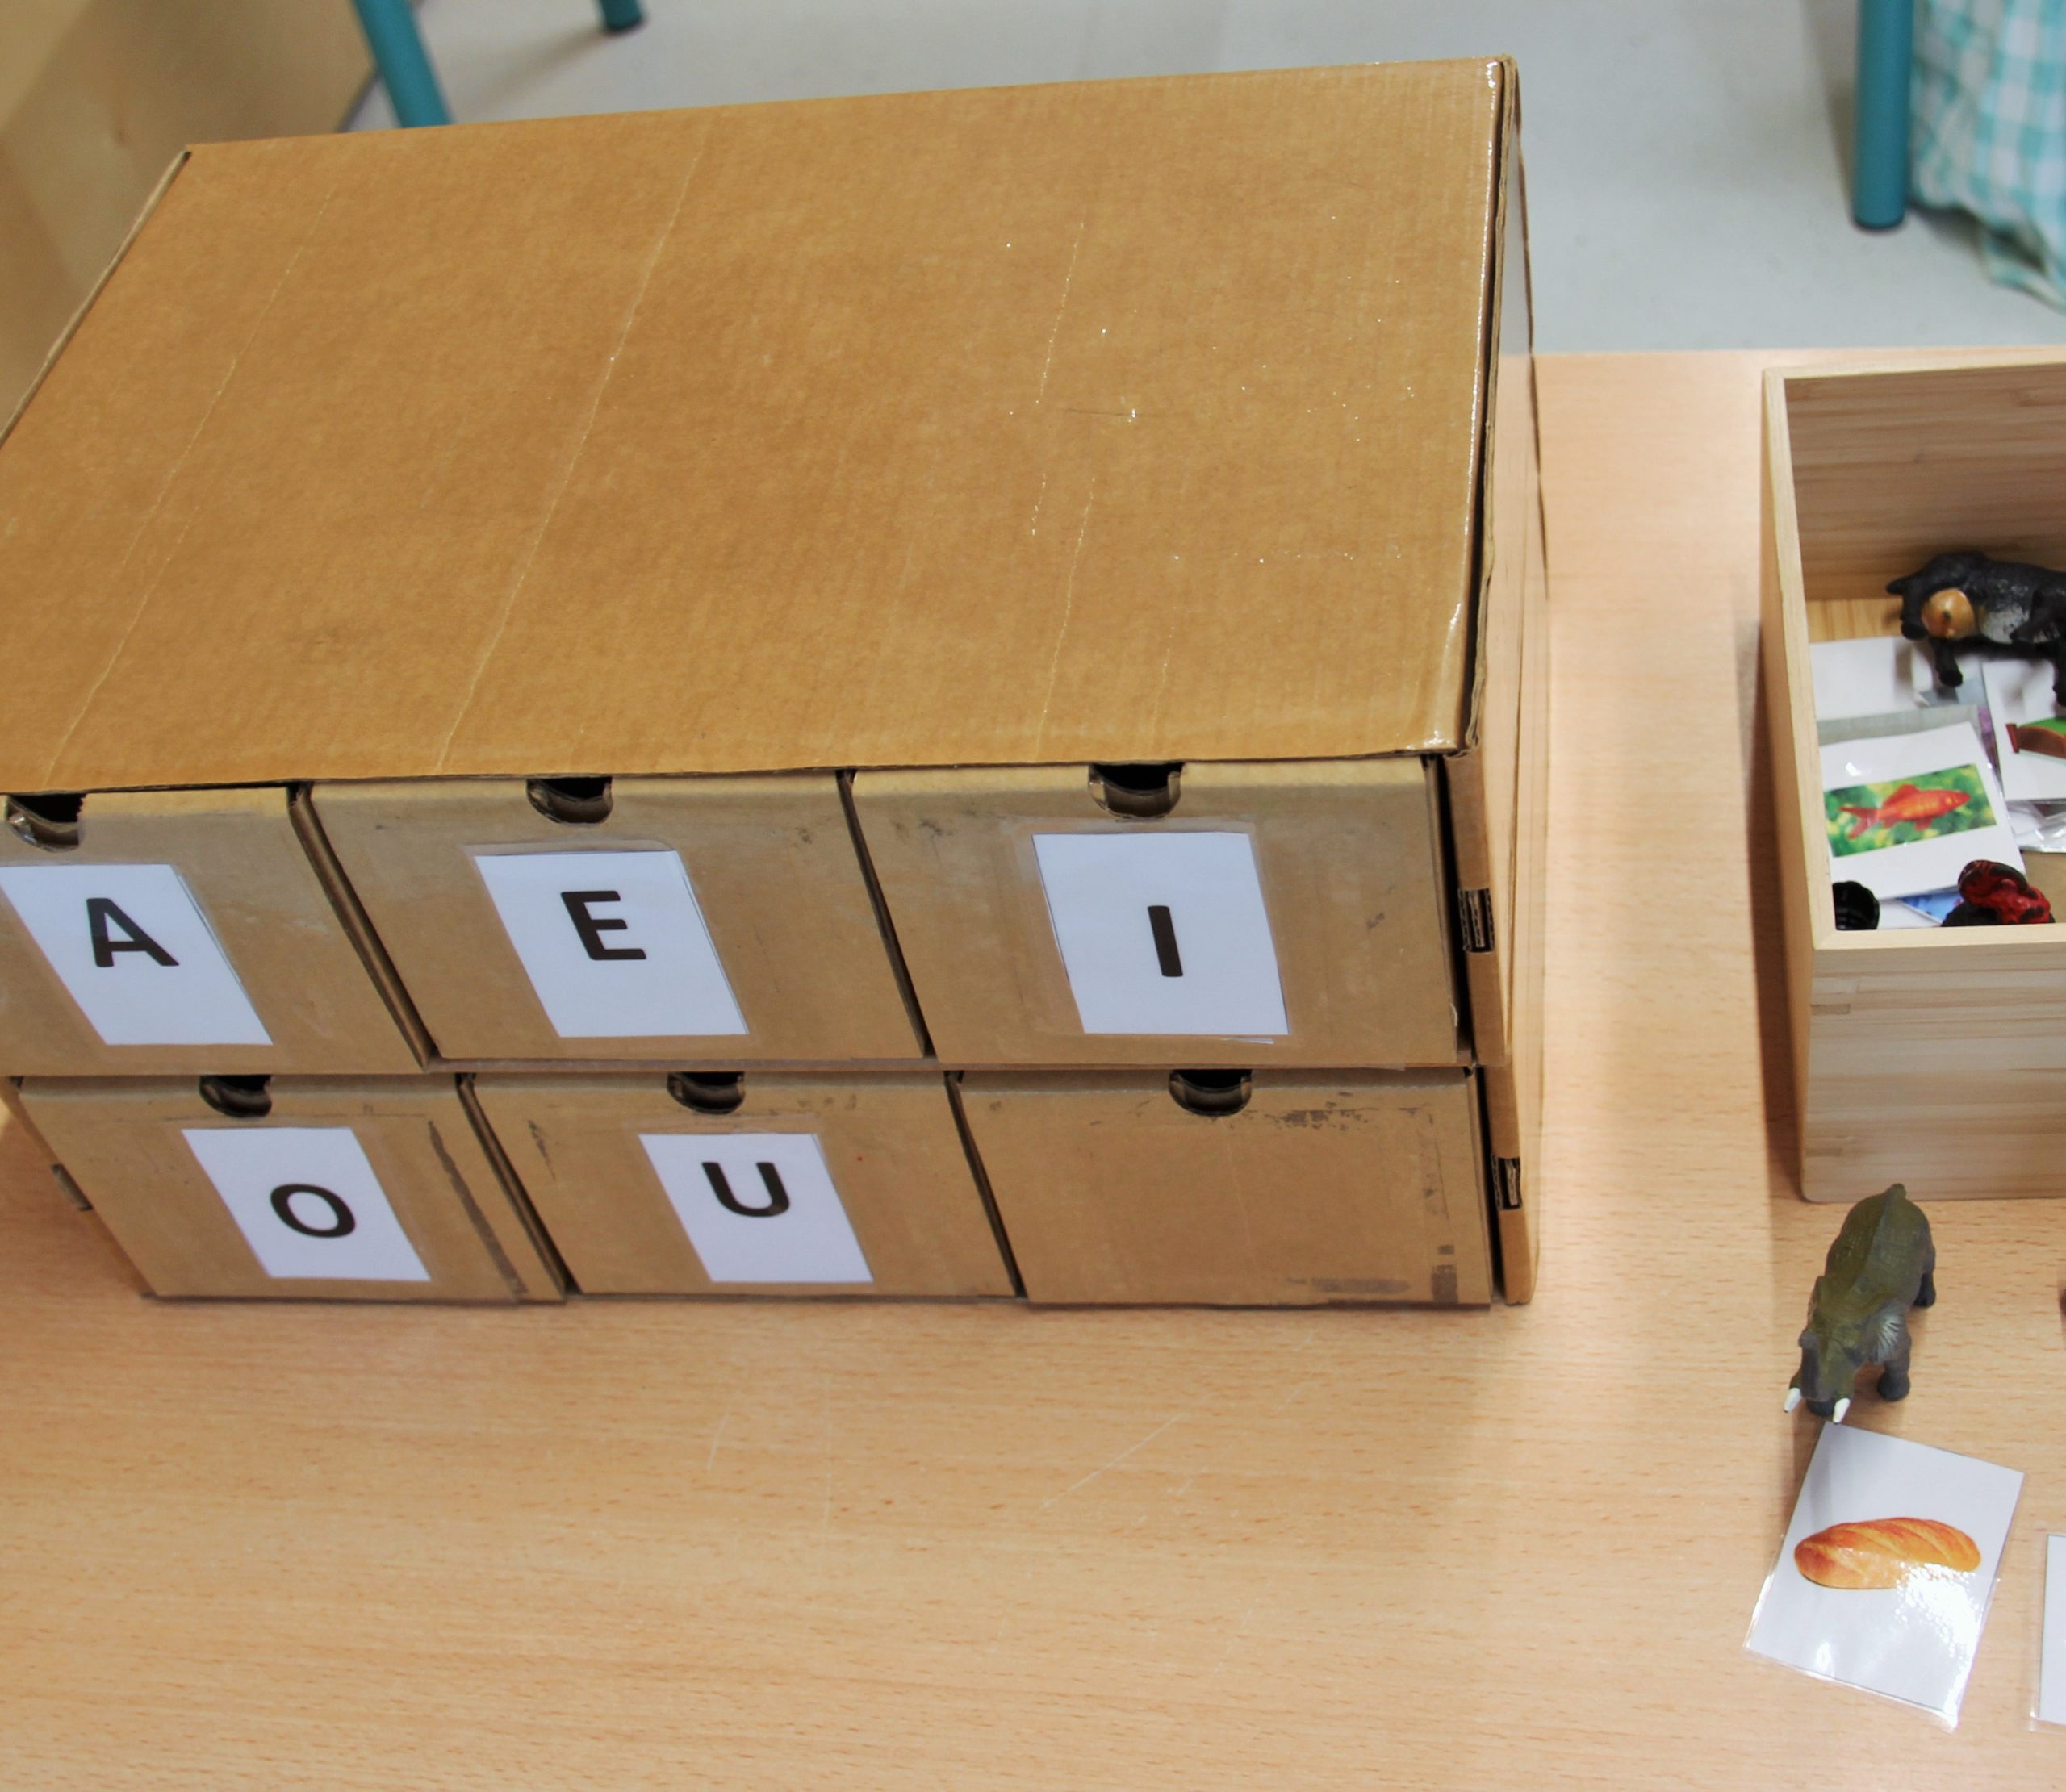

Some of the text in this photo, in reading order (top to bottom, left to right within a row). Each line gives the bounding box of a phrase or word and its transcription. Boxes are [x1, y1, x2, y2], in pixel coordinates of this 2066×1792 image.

[86, 897, 179, 968] A
[560, 890, 646, 961] E
[1147, 905, 1184, 978] I
[270, 1184, 356, 1239] O
[701, 1162, 790, 1218] U
